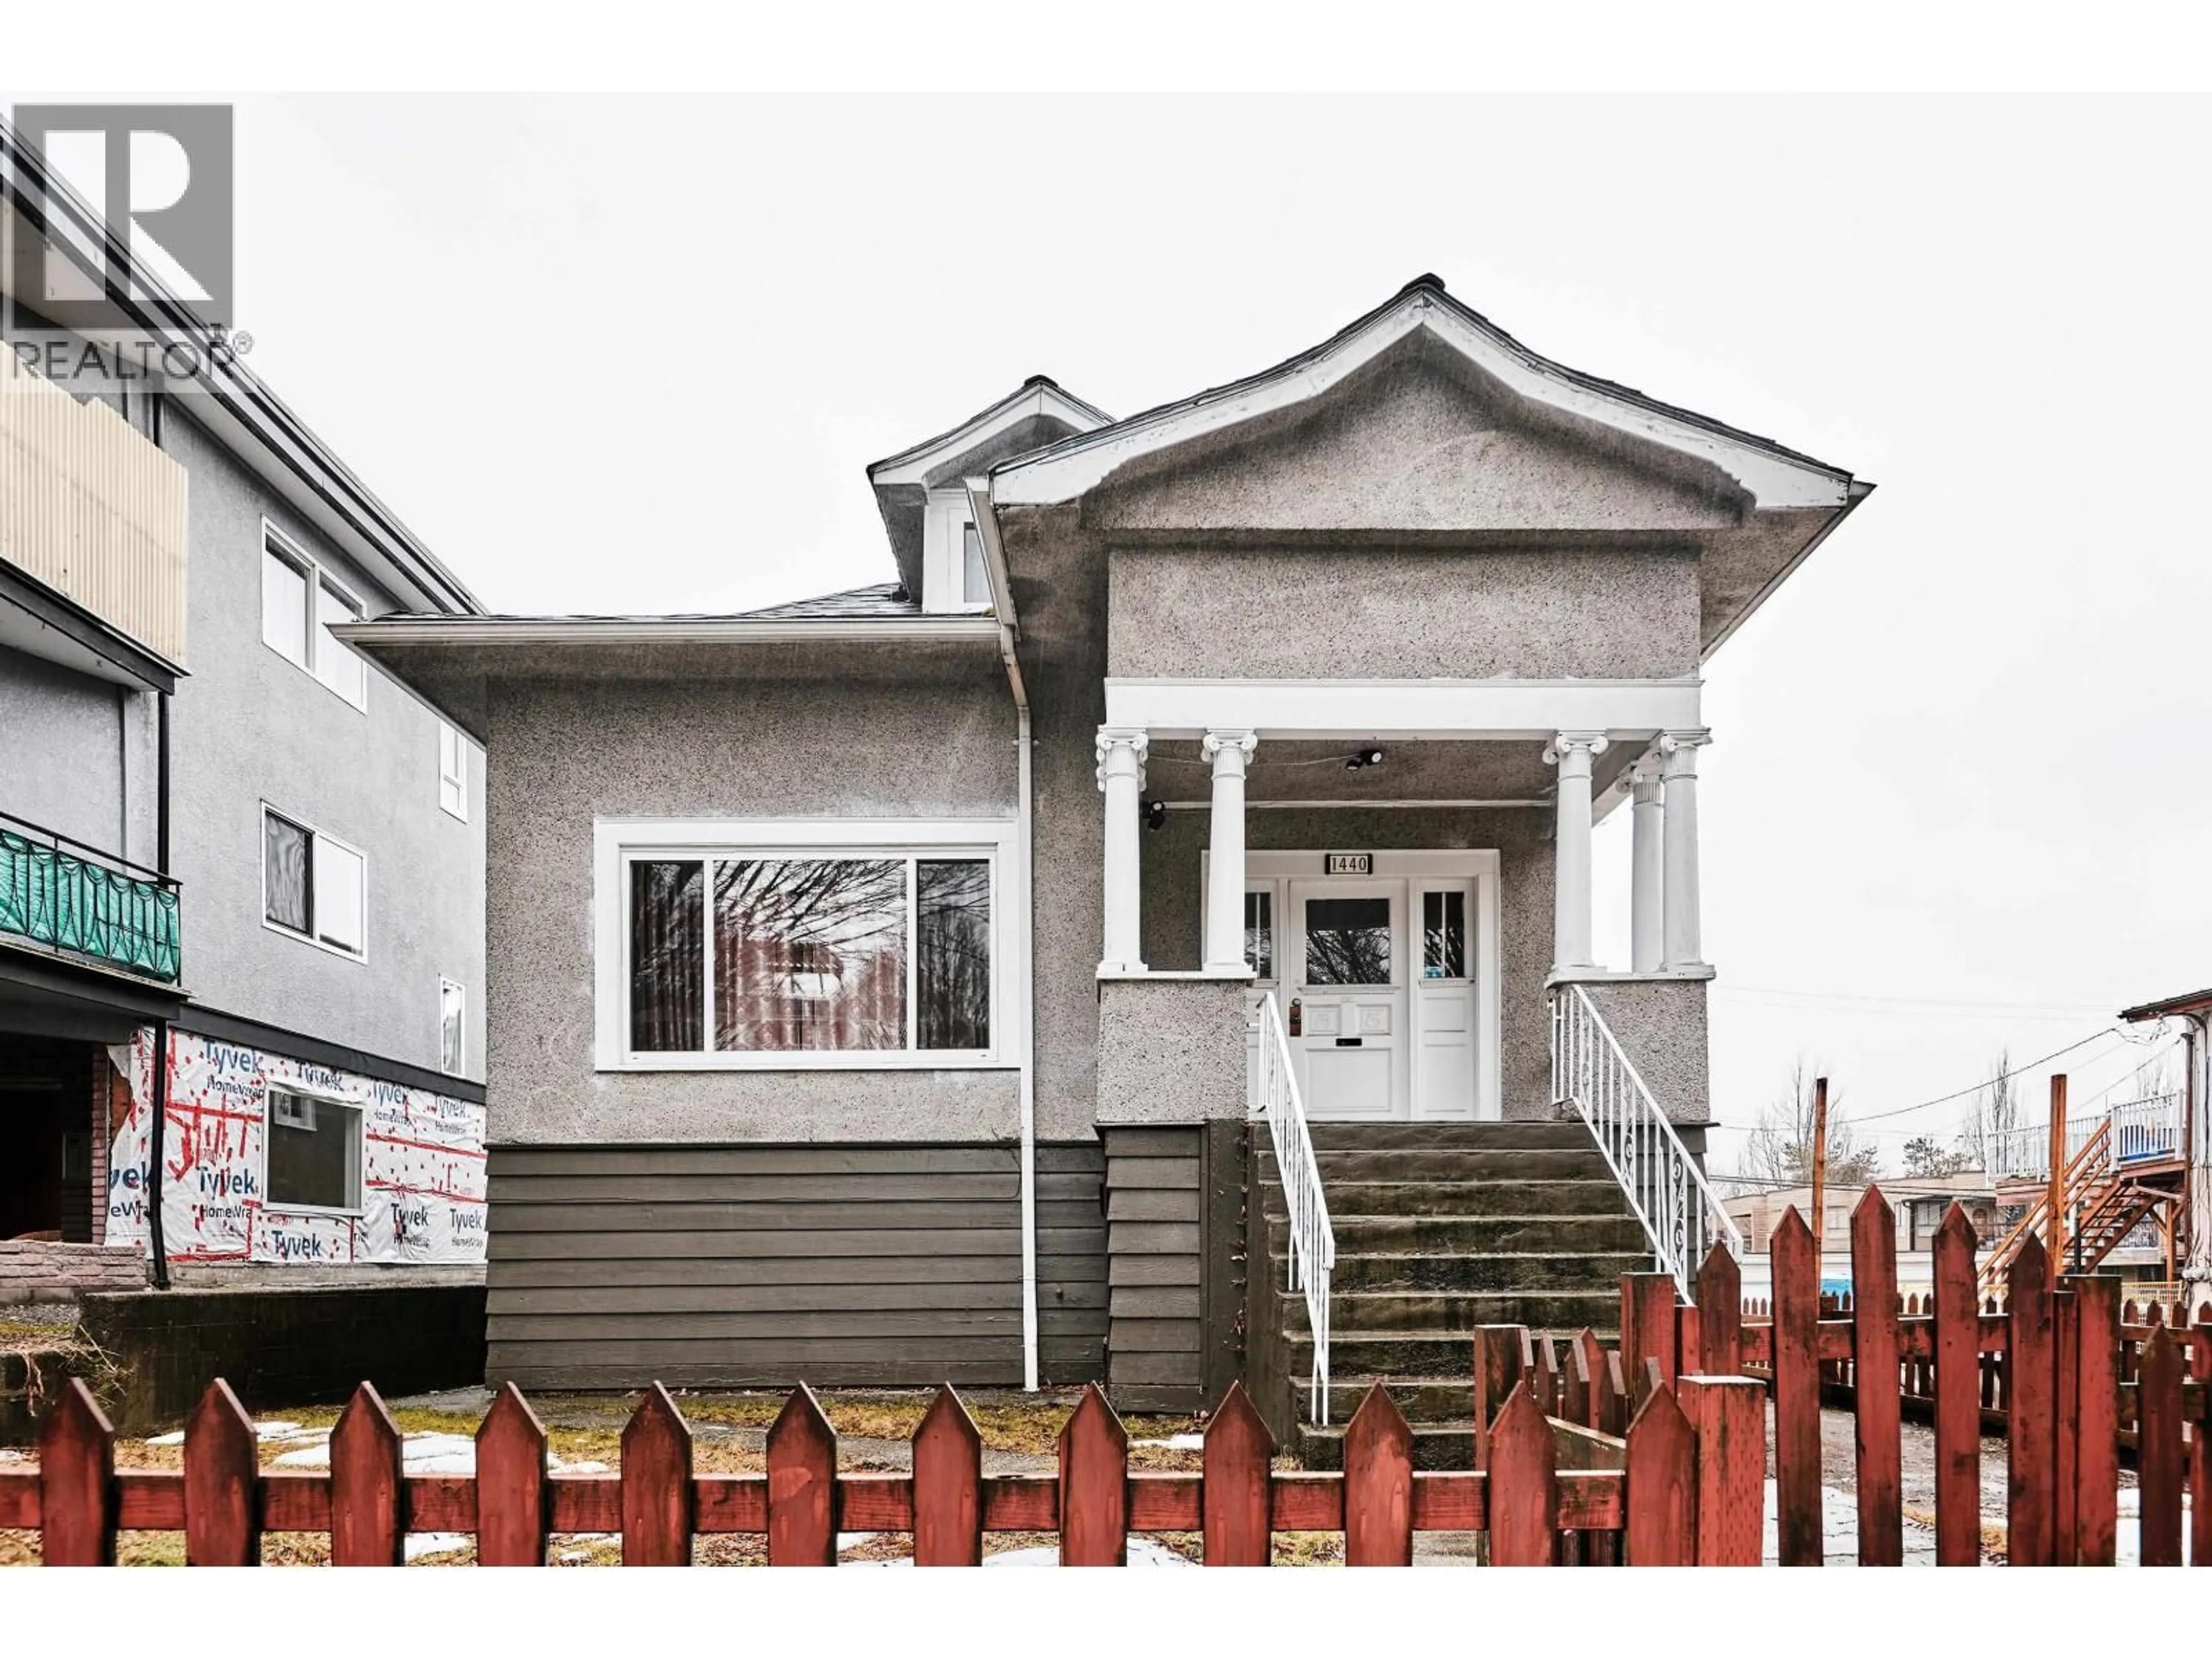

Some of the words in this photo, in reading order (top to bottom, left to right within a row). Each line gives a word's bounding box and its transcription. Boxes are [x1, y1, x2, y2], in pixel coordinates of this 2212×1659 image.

[1331, 857, 1367, 871] 1440
[202, 1037, 263, 1074] Tyvek
[449, 1209, 482, 1234] Tyvek
[271, 1230, 320, 1260] Tyvek
